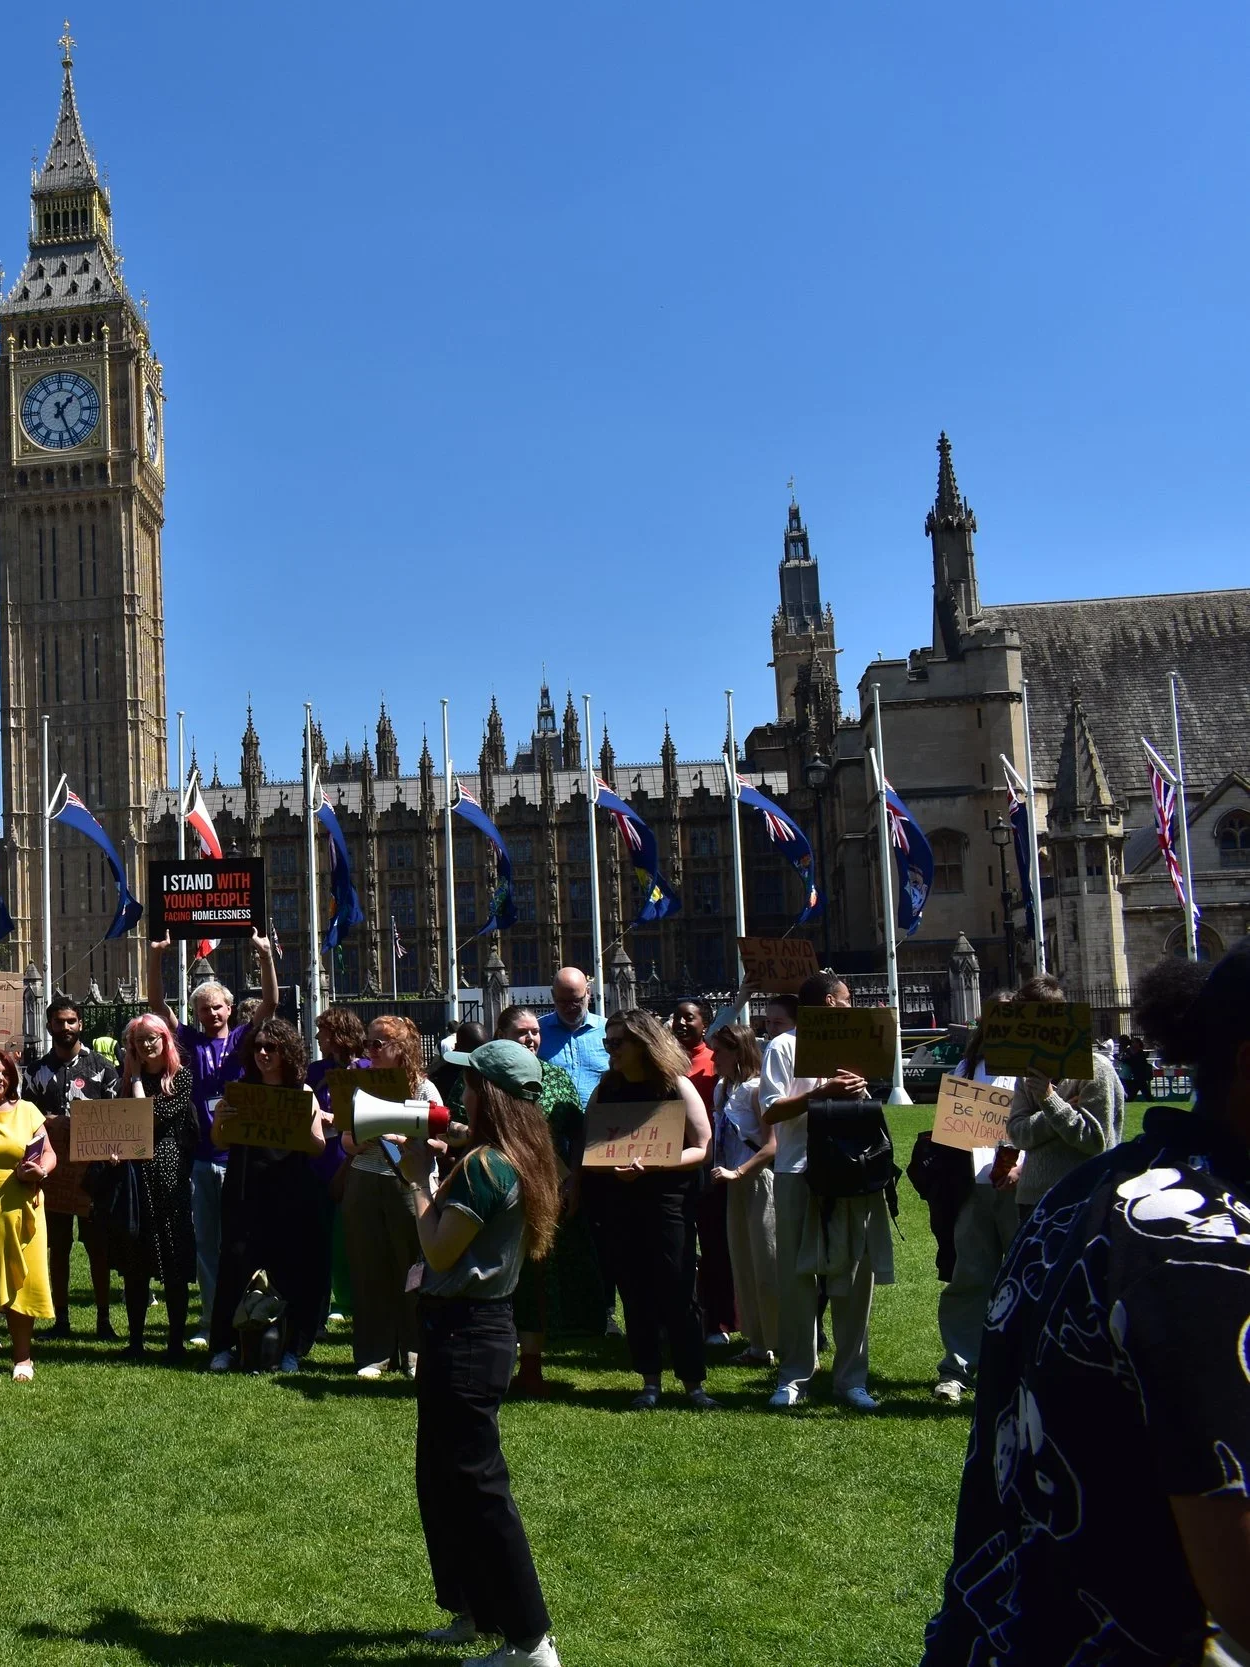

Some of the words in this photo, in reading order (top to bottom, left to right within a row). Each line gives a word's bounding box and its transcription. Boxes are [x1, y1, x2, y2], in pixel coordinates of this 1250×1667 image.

[163, 875, 167, 892] I
[171, 873, 213, 891] STAND
[217, 872, 250, 889] WITH
[164, 893, 203, 909] YOUNG
[206, 891, 250, 908] PEOPLE
[164, 911, 190, 922] FACING
[192, 909, 251, 920] HOMELESSNESS
[741, 938, 755, 955] I
[759, 939, 813, 957] STAND
[744, 959, 778, 981] FOR
[800, 1011, 850, 1028] SAFETY
[989, 1003, 1027, 1019] ASK
[1035, 1002, 1065, 1018] ME
[800, 1028, 863, 1041] STABILITY
[869, 1024, 884, 1048] 4
[1015, 1022, 1075, 1047] STORY
[369, 1069, 397, 1084] THE
[226, 1086, 268, 1105] END
[273, 1089, 306, 1112] THE
[946, 1078, 986, 1101] IT
[80, 1103, 116, 1126] SAFE
[240, 1107, 306, 1128] ENEFIT
[953, 1102, 974, 1116] BE
[76, 1123, 143, 1141] AFFORDABLE
[240, 1122, 295, 1144] TRAP
[76, 1142, 123, 1158] HOUSING
